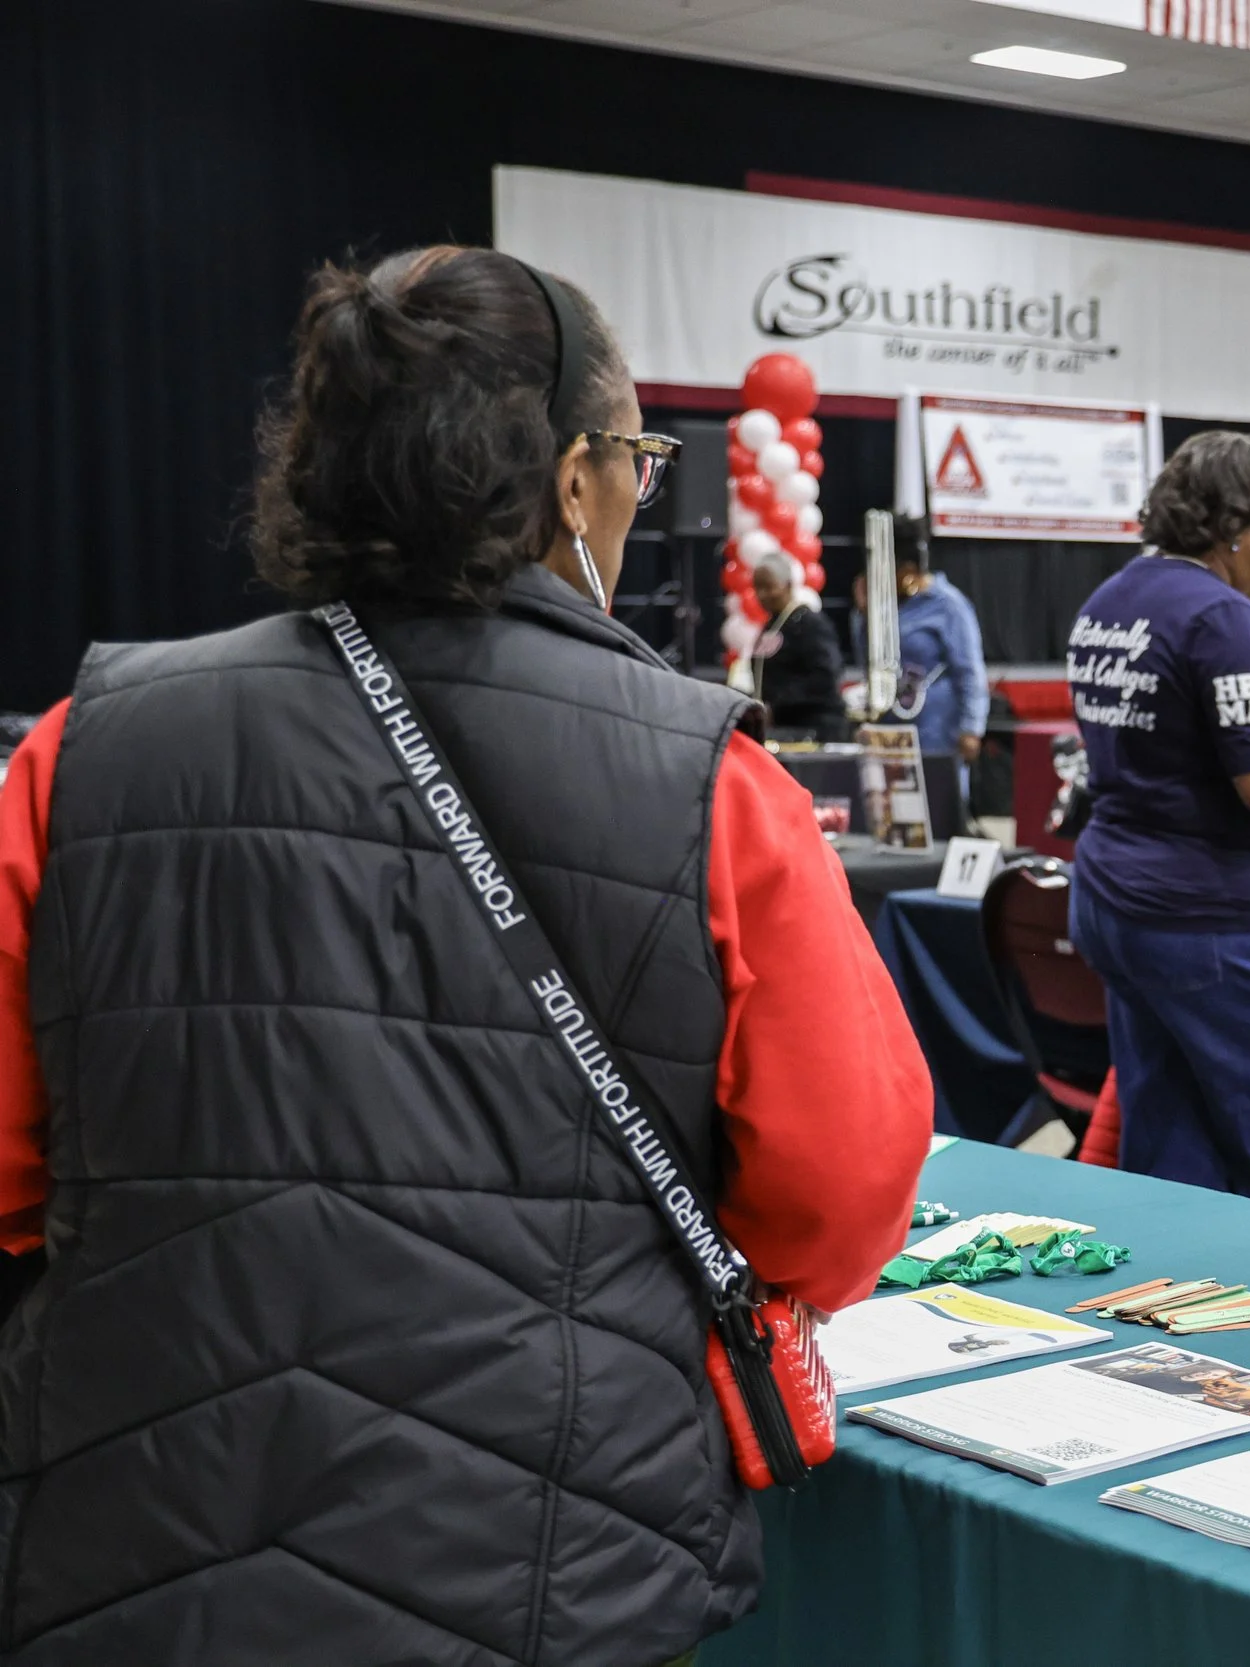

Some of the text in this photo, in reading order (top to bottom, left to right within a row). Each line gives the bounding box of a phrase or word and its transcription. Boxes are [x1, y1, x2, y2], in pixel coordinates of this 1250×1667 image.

[780, 262, 1100, 342] Southfield
[882, 335, 919, 360] the
[1068, 615, 1152, 662] Historically
[1094, 654, 1159, 700] Colleges
[318, 600, 526, 930] FORWARD WITH FORTITUD
[531, 968, 739, 1292] RWARD WITH FORTITUDE
[874, 1411, 970, 1445] WARRIOR STRONG
[1145, 1488, 1205, 1512] WARRIOR
